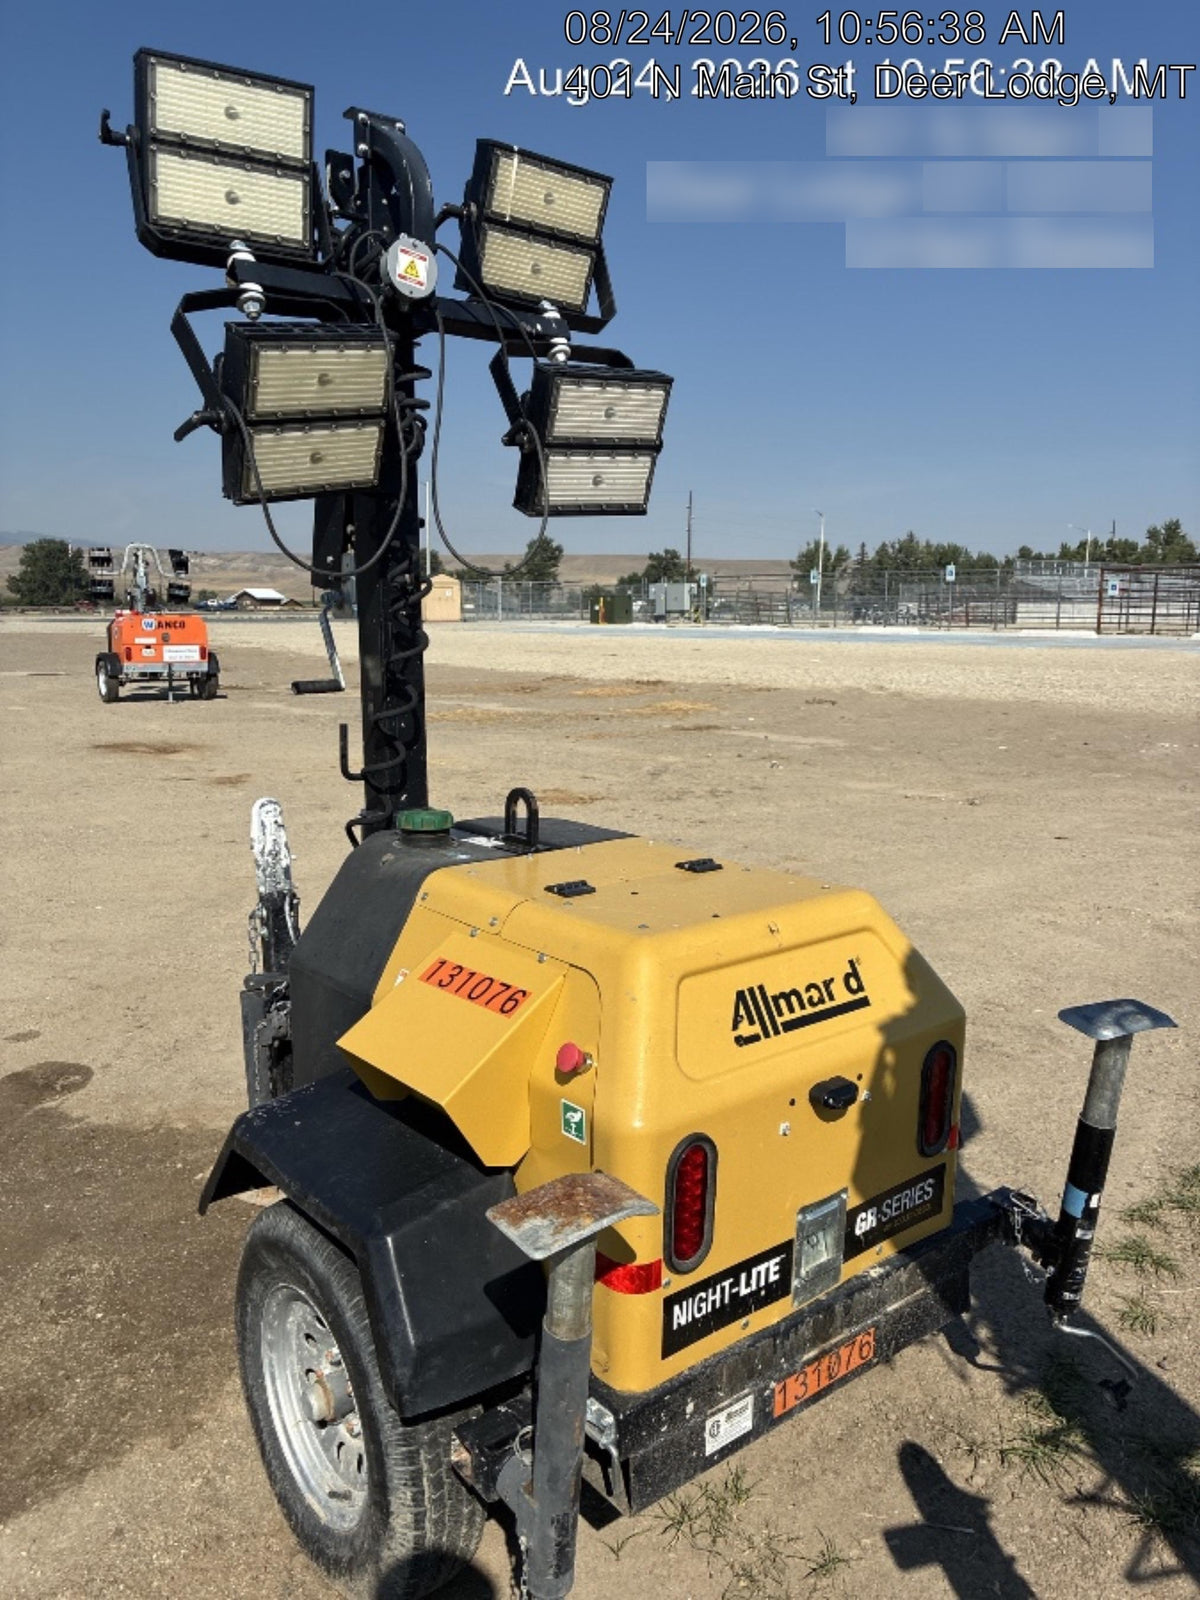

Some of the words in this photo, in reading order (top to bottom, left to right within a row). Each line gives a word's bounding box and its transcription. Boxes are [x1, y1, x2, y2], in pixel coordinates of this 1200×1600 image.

[426, 959, 527, 1015] 131076
[672, 1255, 783, 1331] NIGHT-LITE
[777, 1332, 873, 1411] 131076
